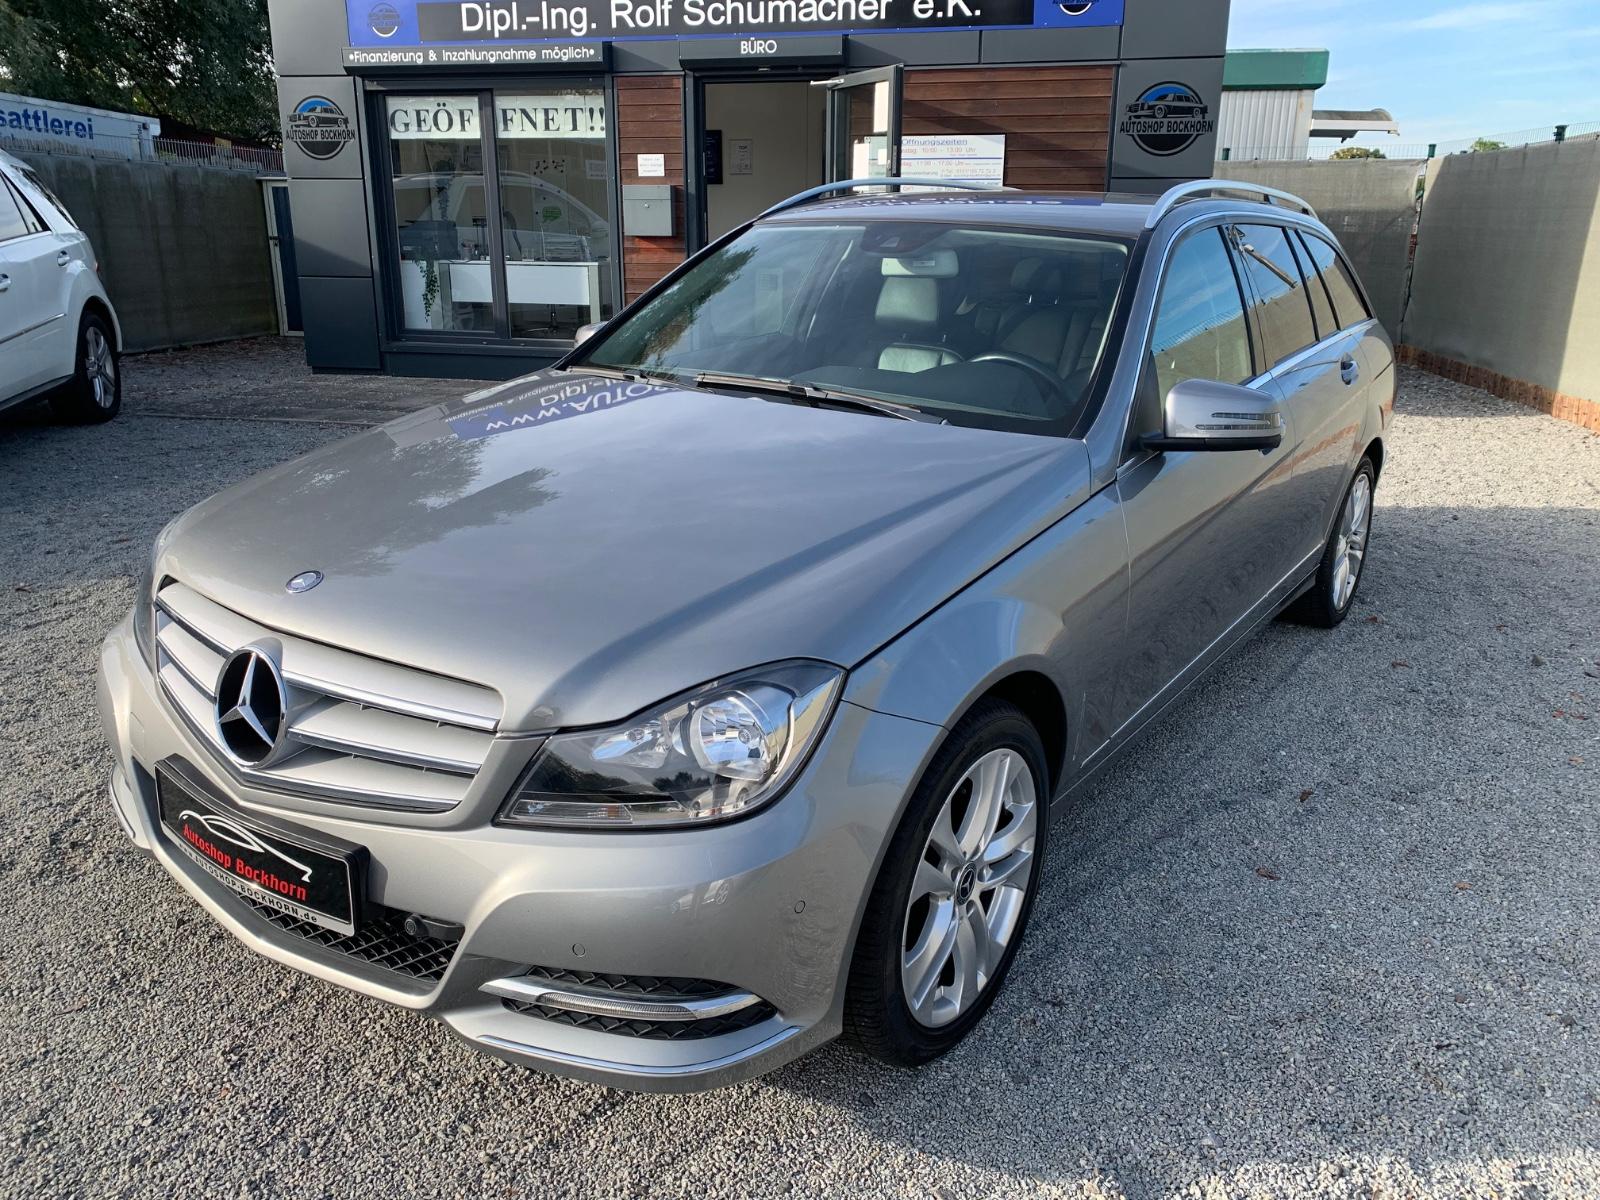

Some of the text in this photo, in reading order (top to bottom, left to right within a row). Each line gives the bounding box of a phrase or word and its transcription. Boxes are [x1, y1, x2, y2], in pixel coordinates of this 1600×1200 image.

[460, 0, 982, 38] Dipl.-Ing. Rolf Schumacher e.K.
[740, 37, 777, 55] BÜRO
[428, 50, 438, 62] &
[442, 49, 537, 62] Inzahlungnahme
[389, 101, 474, 134] GEÖF
[1119, 120, 1214, 133] AUTOSHOP BOCKHORN
[285, 129, 356, 141] AUTOSHOP BOCKHORN
[182, 823, 307, 901] Autoshop Bockhorn
